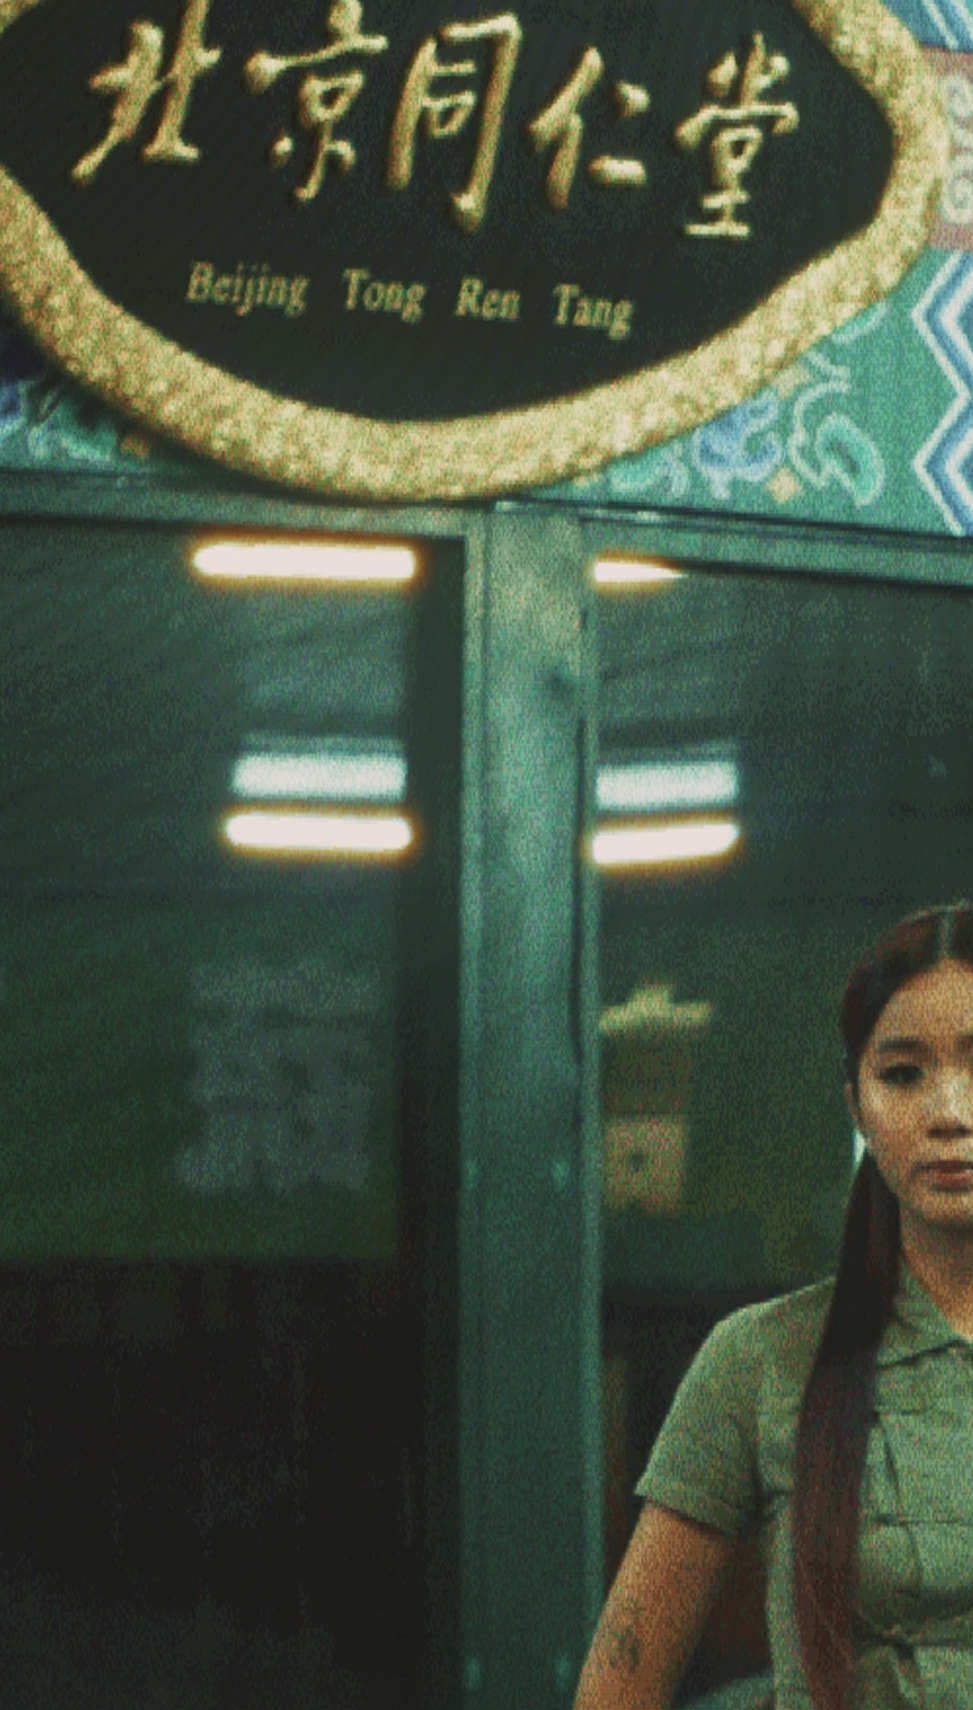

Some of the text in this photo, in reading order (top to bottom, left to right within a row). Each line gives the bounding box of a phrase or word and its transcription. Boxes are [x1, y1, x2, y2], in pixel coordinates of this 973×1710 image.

[72, 0, 798, 239] 北京同仁堂
[186, 260, 633, 341] Beijing Tong Ren Tang
